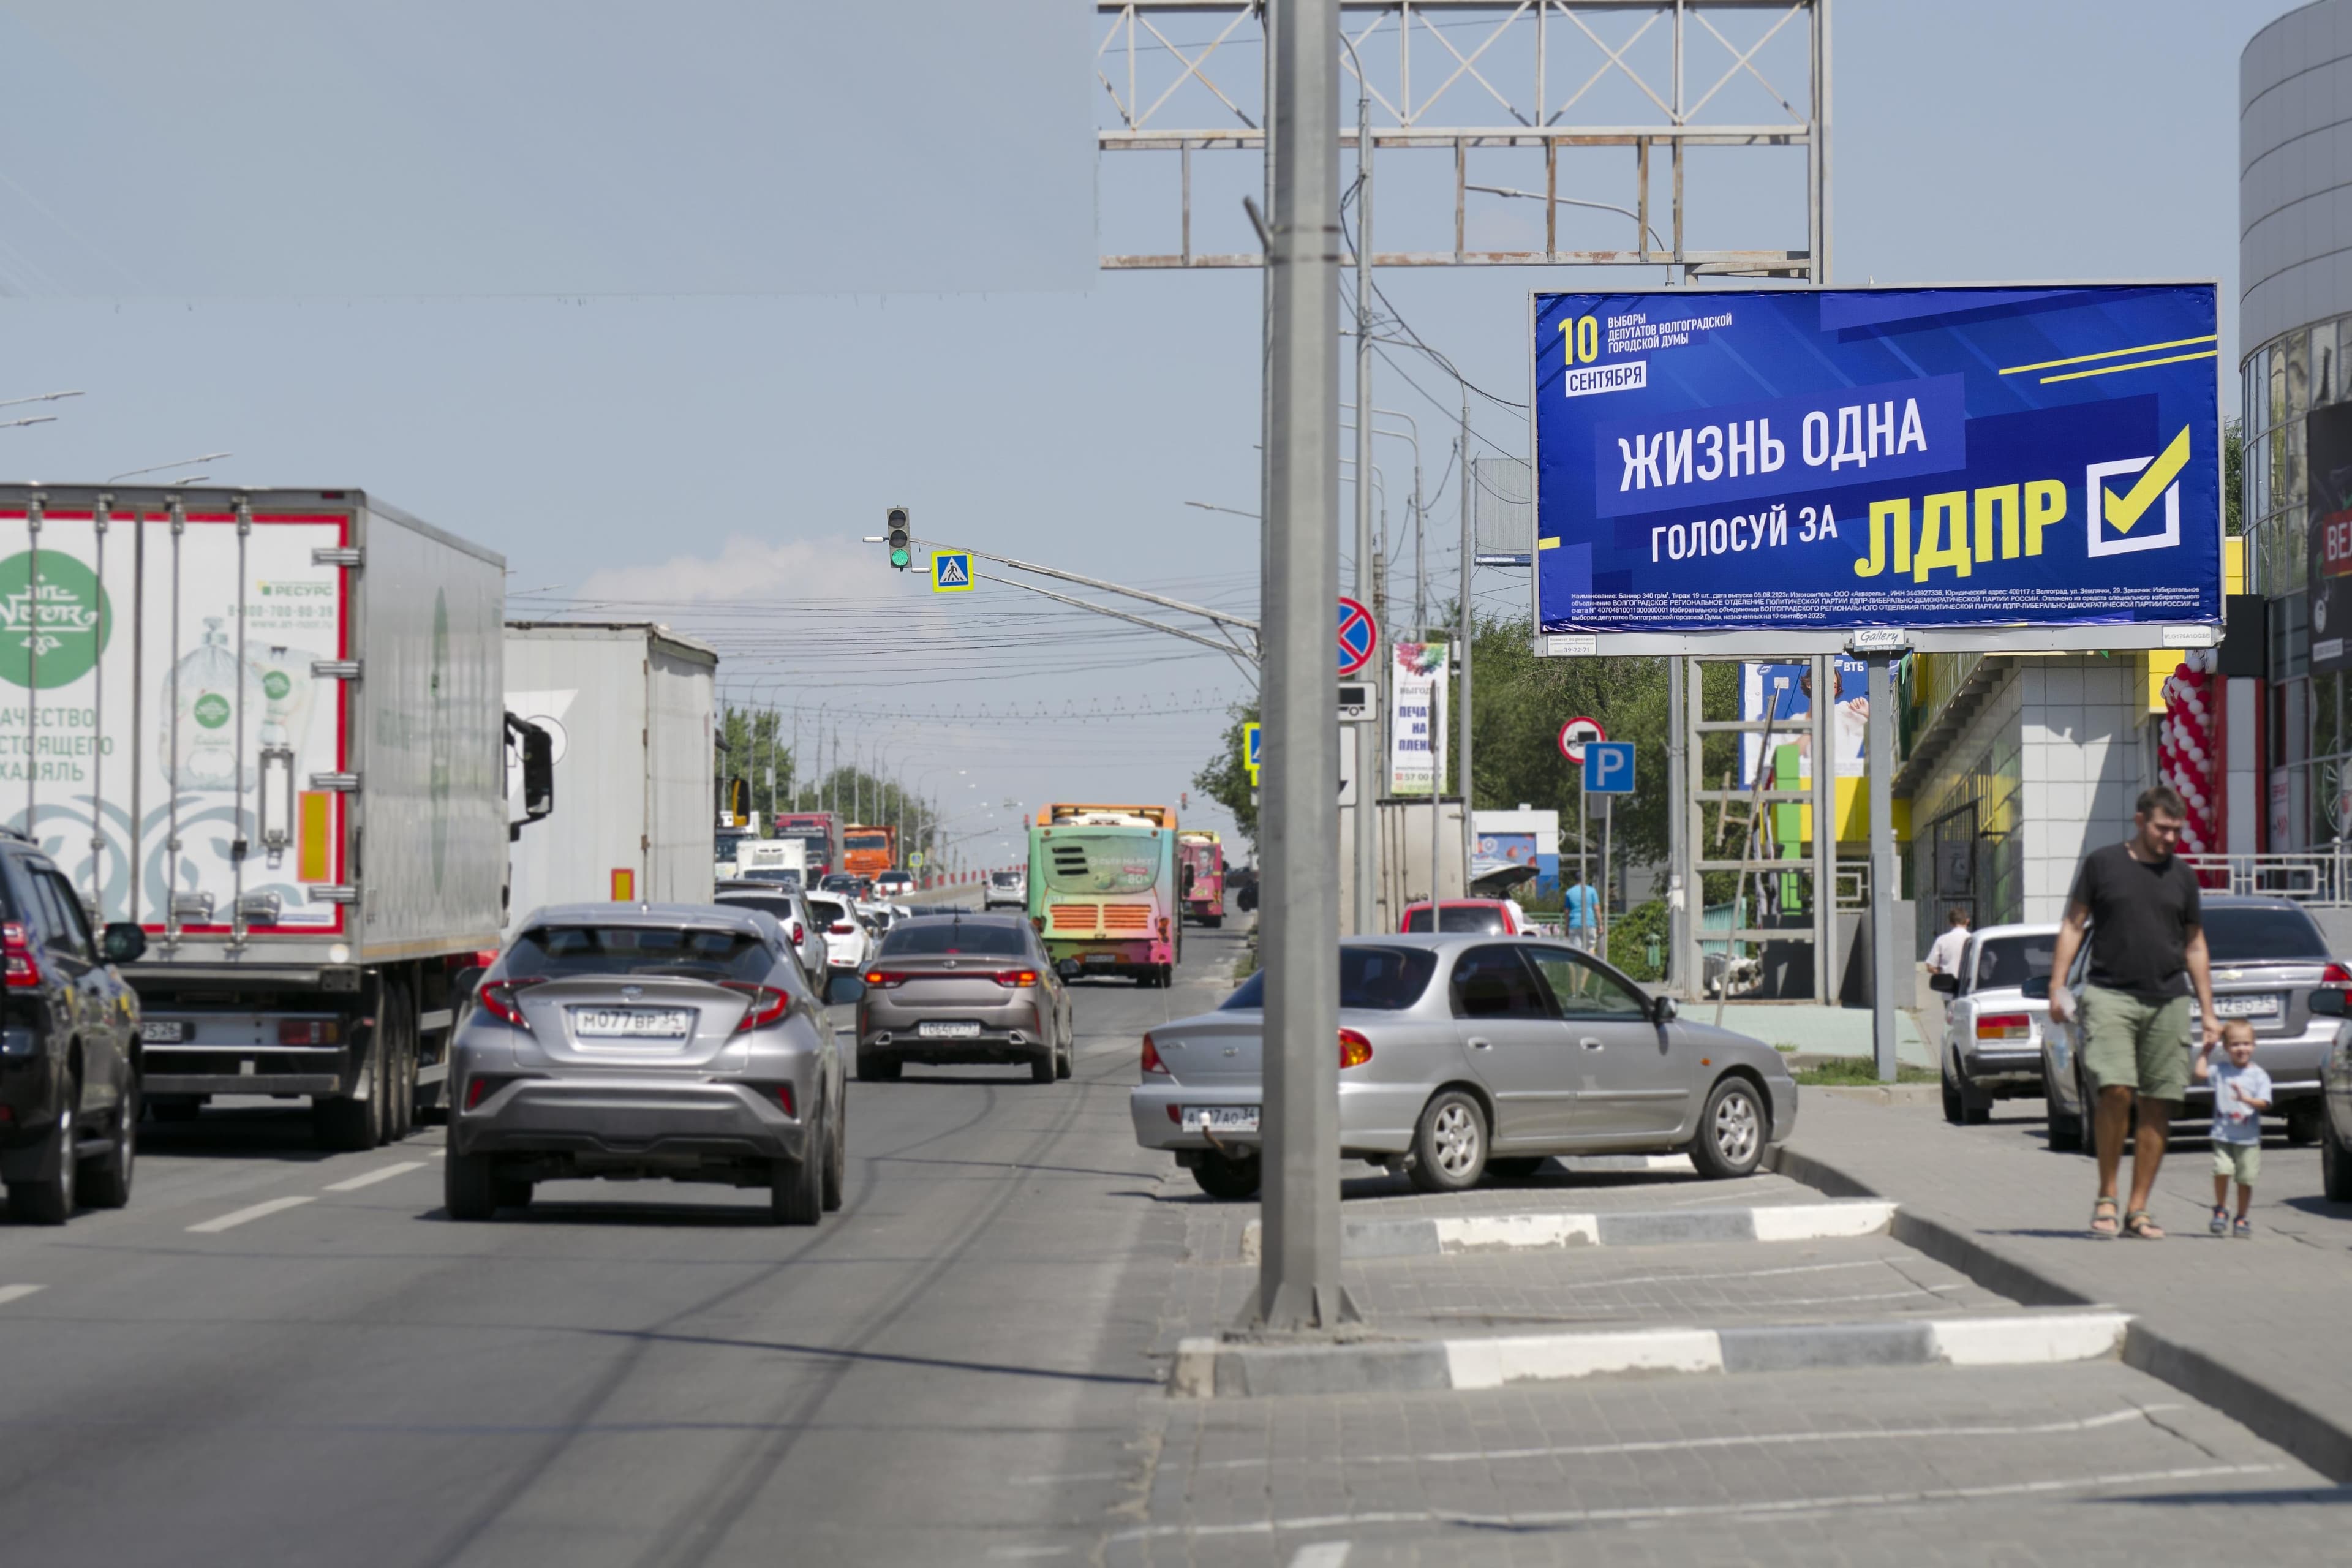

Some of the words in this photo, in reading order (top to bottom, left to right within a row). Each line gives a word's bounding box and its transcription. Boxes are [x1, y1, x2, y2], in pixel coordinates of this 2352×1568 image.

[1608, 313, 1646, 328] ВЫБОРЫ
[1608, 324, 1657, 342] ДЕПУТАТОВ
[1659, 312, 1732, 333] ВОЛГОГРАДСКОЙ
[1558, 315, 1598, 366] 10
[1608, 337, 1659, 353] ГОРОДСКОЙ
[1661, 333, 1689, 349] ДУМЫ
[1570, 366, 1642, 392] СЕНТЯБРЯ
[1618, 417, 1785, 491] ЖИЗНЬ
[1802, 398, 1927, 472] ОДНА
[1651, 500, 1788, 562] ГОЛОСУЙ
[1798, 503, 1838, 542] ЗА
[1853, 478, 2067, 583] ЛДПР
[275, 586, 333, 596] РЕСУРС
[1860, 630, 1899, 645] Gallery
[1844, 662, 1864, 671] ВТБ
[1412, 723, 1426, 734] НА
[1597, 748, 1624, 786] P
[583, 1011, 656, 1028] М077ВР
[1188, 1108, 1238, 1124] А7АО
